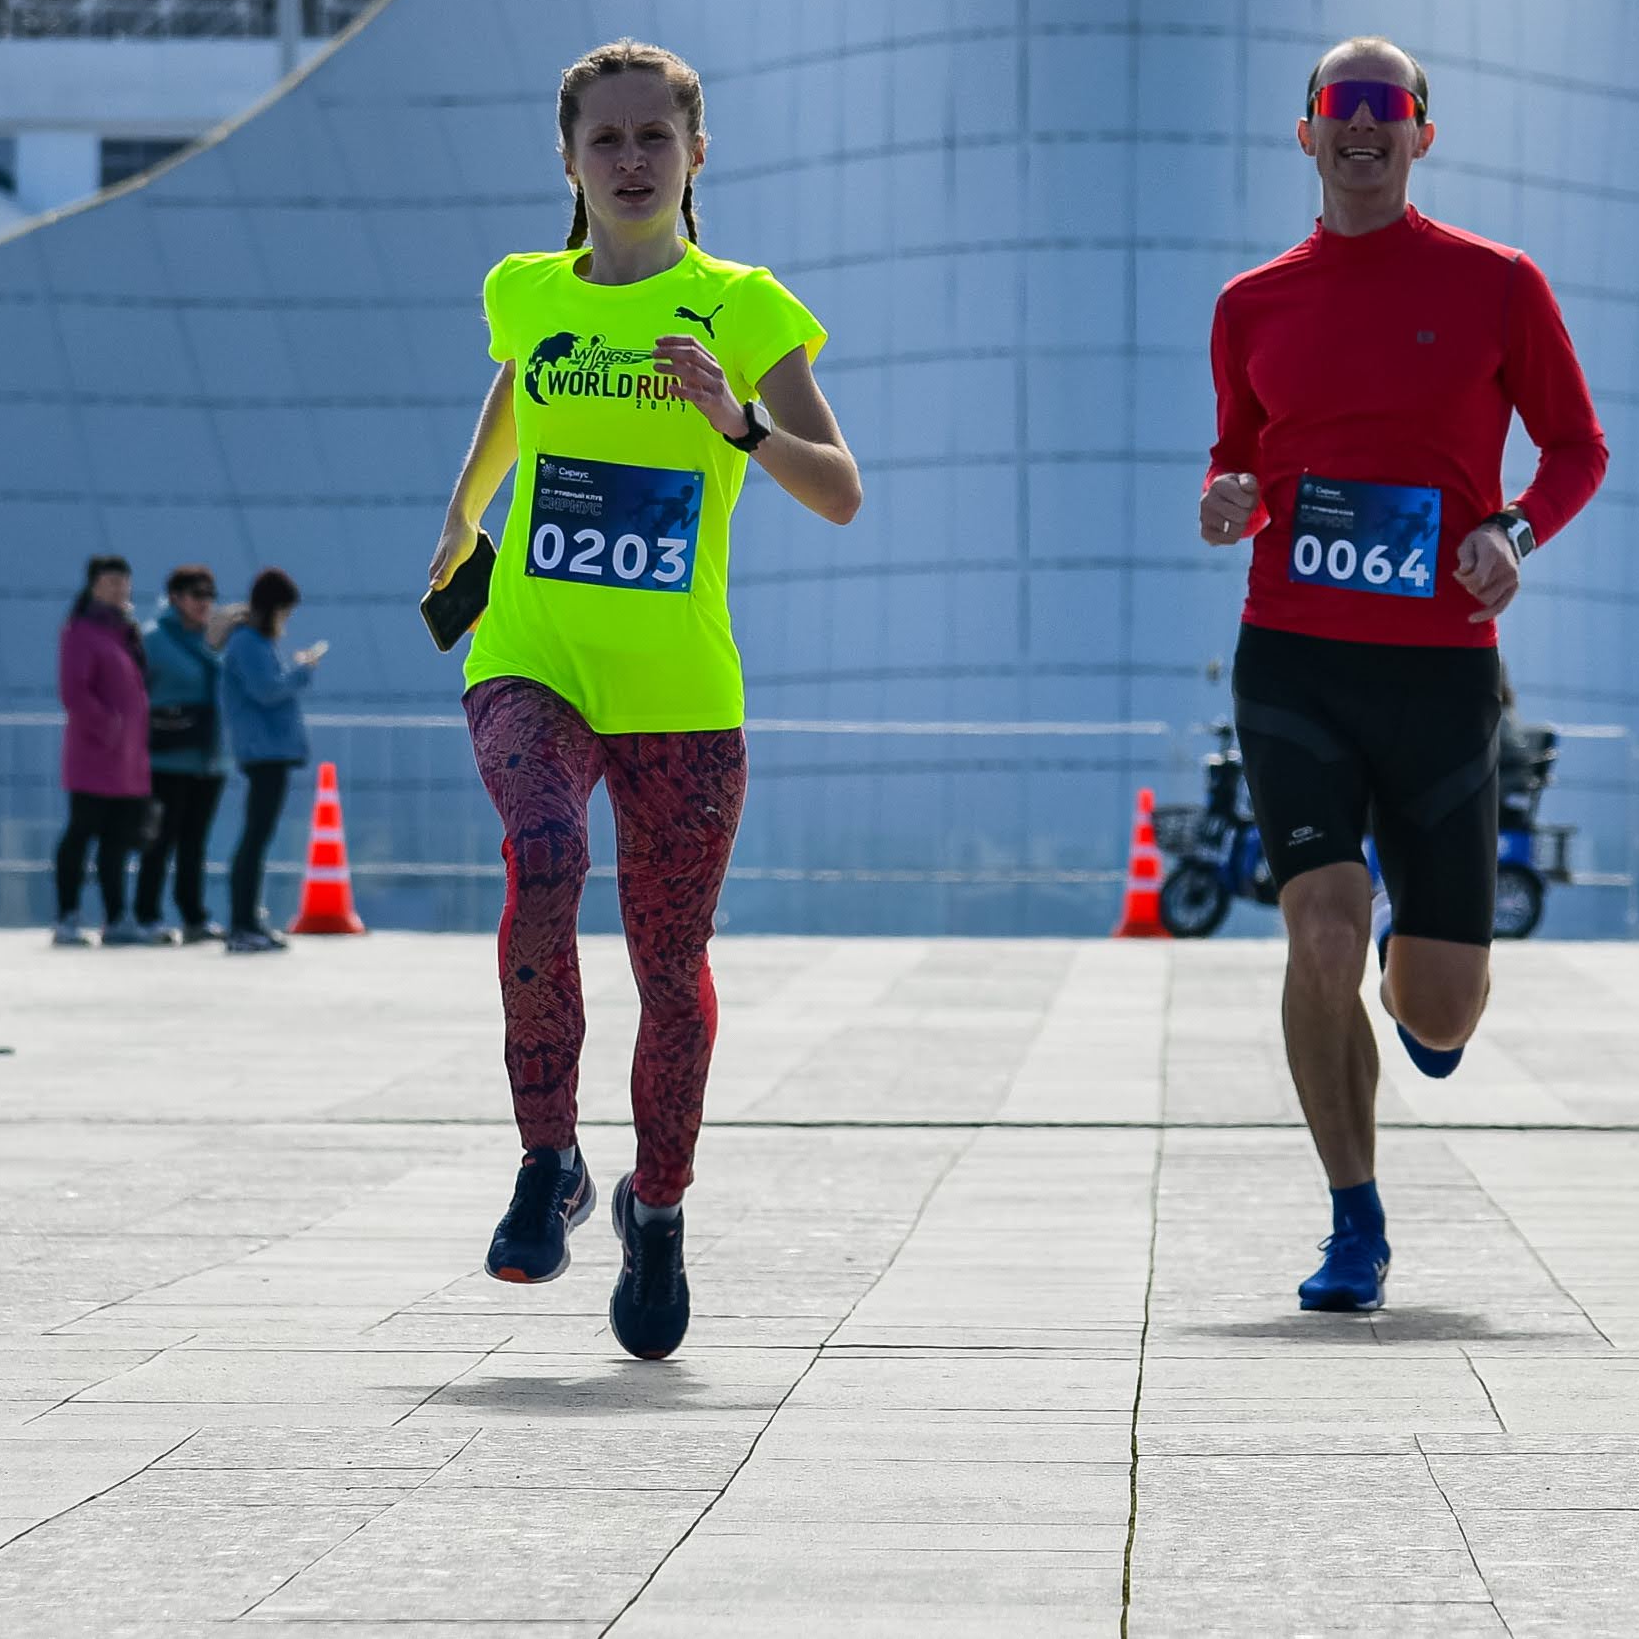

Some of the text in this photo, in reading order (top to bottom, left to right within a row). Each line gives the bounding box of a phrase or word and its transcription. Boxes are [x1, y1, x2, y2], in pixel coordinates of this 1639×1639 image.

[547, 370, 633, 399] WORLD
[636, 400, 686, 413] 2017
[558, 466, 590, 481] Сириус
[533, 523, 687, 582] 0203
[1294, 534, 1430, 587] 0064
